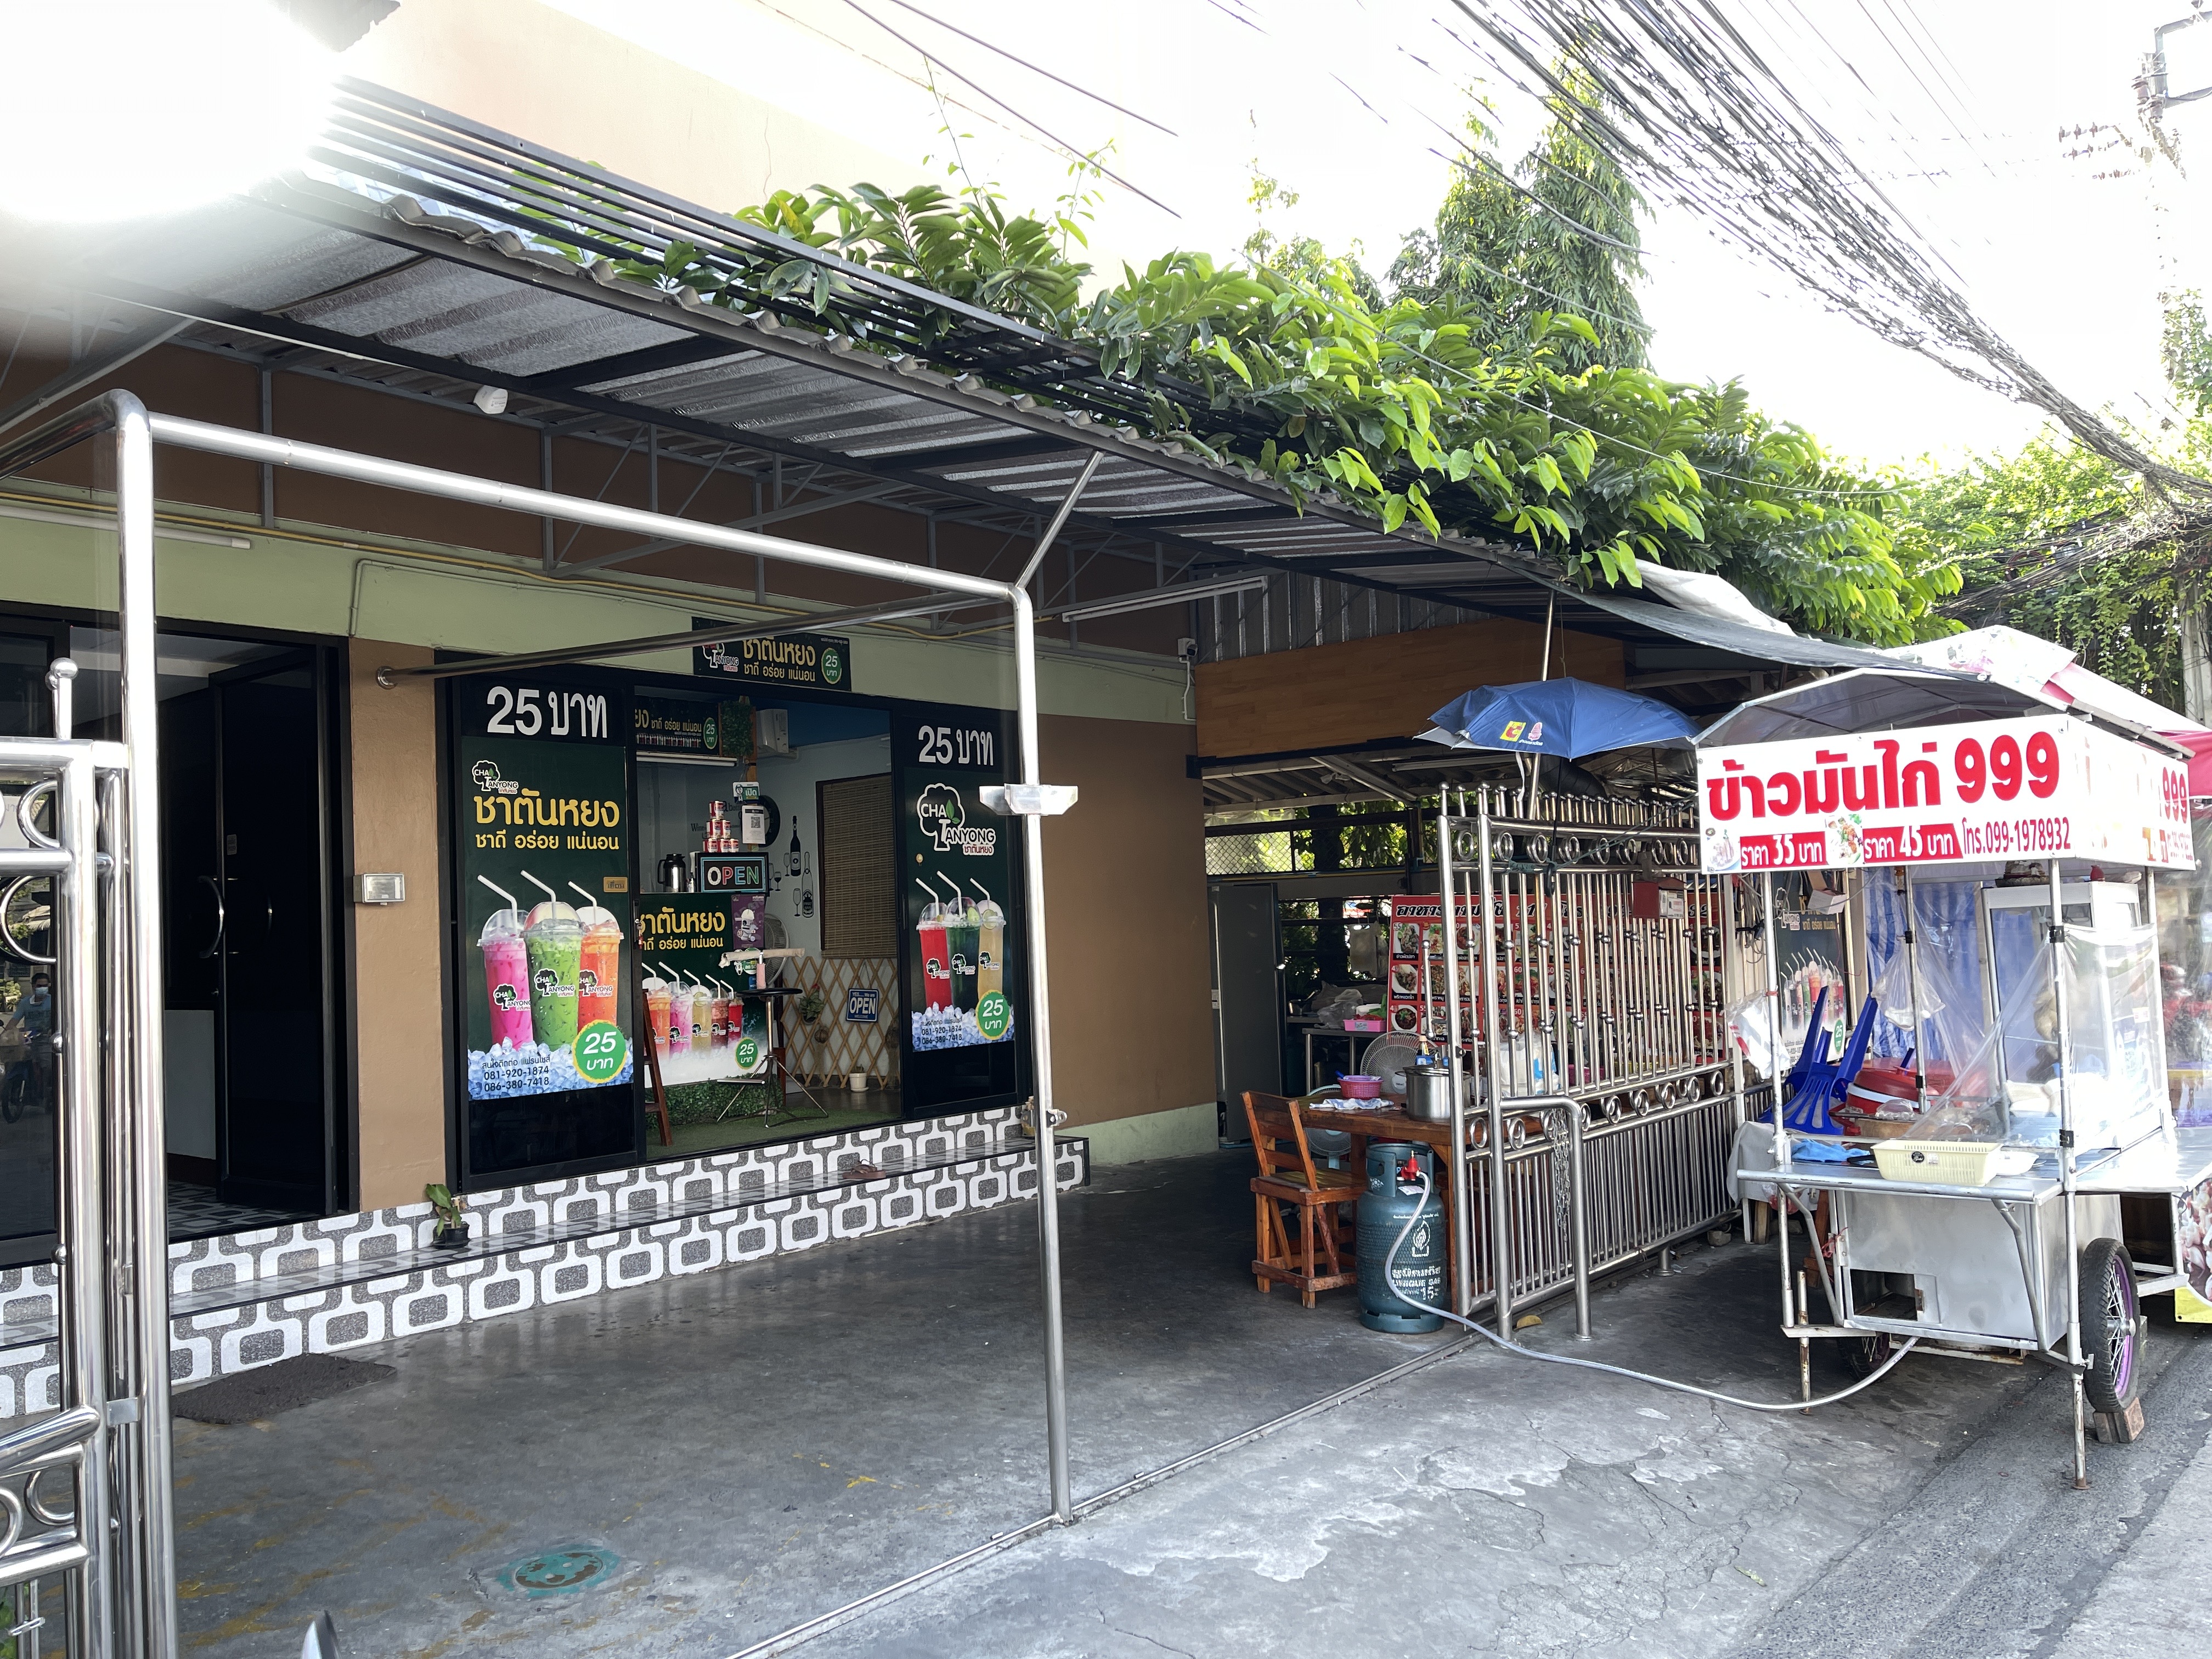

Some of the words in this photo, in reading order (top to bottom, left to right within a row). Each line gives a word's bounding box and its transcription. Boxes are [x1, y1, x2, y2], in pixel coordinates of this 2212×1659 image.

[712, 650, 739, 666] TANYONG
[743, 636, 816, 666] ชาตันหยง
[825, 654, 838, 668] 25
[744, 662, 759, 676] ชาดี
[763, 664, 785, 679] อร่อย
[788, 666, 816, 682] แน่นอน
[487, 686, 542, 736] 25
[548, 691, 607, 738] บาท
[706, 724, 715, 735] 25
[918, 725, 953, 764] 25
[956, 729, 994, 765] บาท
[484, 776, 518, 788] TANYONG
[1707, 739, 1941, 821] ข้าวมันไก่
[1955, 731, 2059, 803] 999
[745, 788, 758, 796] เปิด
[2162, 766, 2188, 824] 999
[473, 788, 620, 827] ชาตันหยง
[920, 803, 947, 818] CHA
[475, 829, 506, 849] ชาดี
[515, 830, 559, 849] อร่อย
[567, 831, 619, 850] แน่นอน
[938, 819, 996, 844] TANYONG
[964, 844, 993, 854] ชาตันหยง
[1741, 845, 1769, 866] ราคา
[1773, 834, 1795, 865] 35
[1799, 842, 1823, 864] บาท
[1864, 837, 1895, 859] ราคา
[1899, 825, 1923, 857] 45
[1927, 834, 1954, 856] บาท
[1962, 816, 2071, 855] โทร.099-1978932
[707, 866, 759, 885] OPEN
[659, 936, 686, 950] อร่อย
[691, 935, 723, 949] แน่นอน
[545, 983, 574, 992] TANYONG
[585, 984, 613, 992] TANYONG
[849, 997, 876, 1014] OPEN
[983, 998, 1004, 1017] 25
[922, 1025, 962, 1036] 081-920-1874
[985, 1019, 1002, 1030] บาท
[583, 1031, 617, 1055] 25
[922, 1034, 962, 1045] 086-380-7418
[739, 1043, 754, 1056] 25
[586, 1058, 613, 1071] บาท
[484, 1065, 549, 1081] 081-920-1874
[484, 1076, 549, 1092] 086-380-7418
